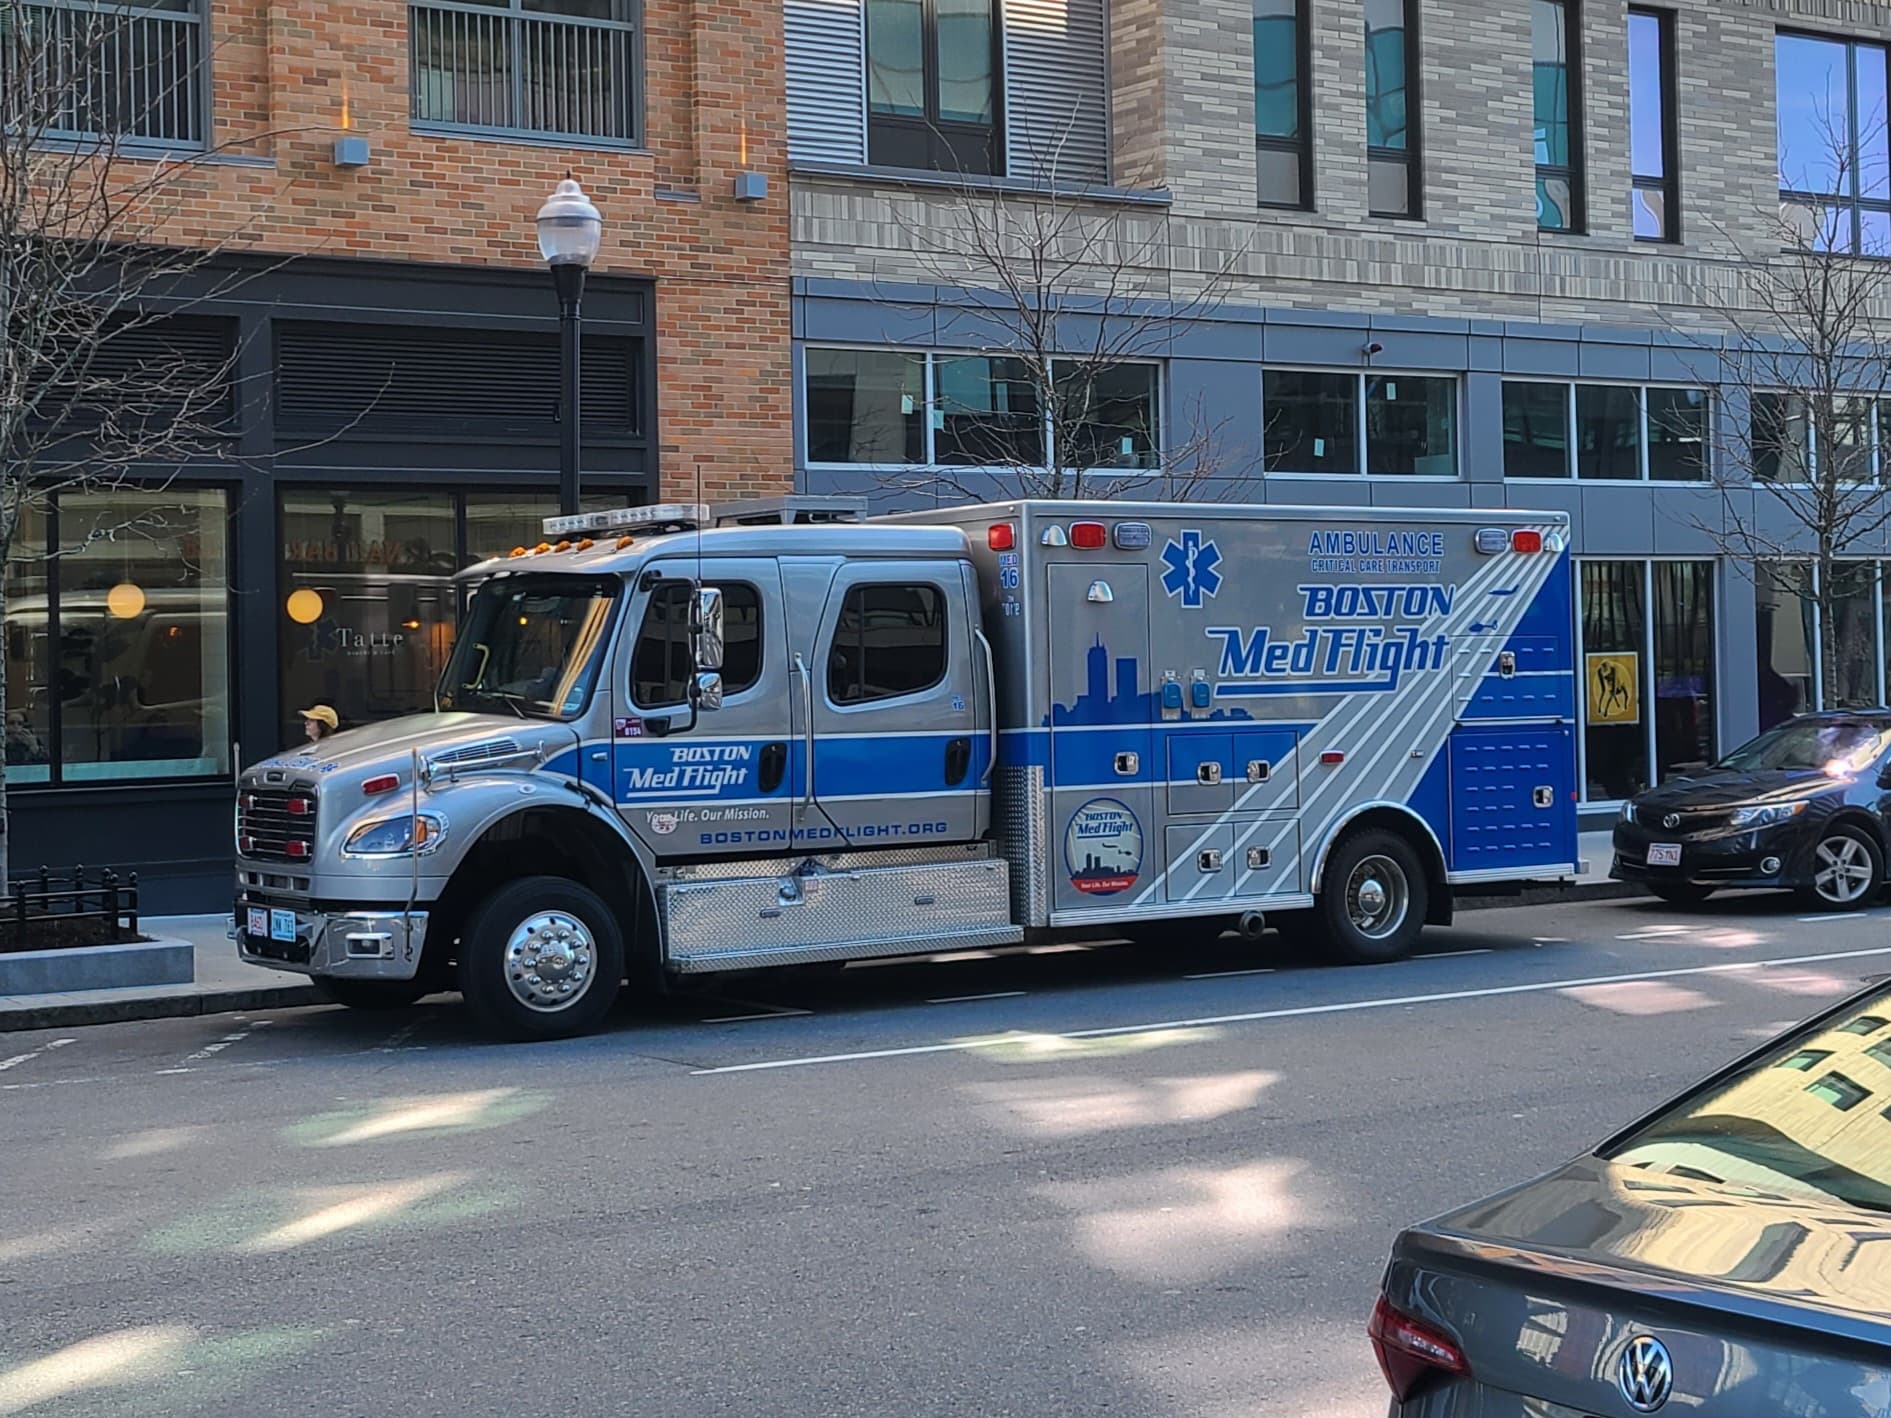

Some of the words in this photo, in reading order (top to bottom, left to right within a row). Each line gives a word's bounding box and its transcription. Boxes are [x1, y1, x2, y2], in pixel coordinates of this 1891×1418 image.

[1308, 531, 1444, 556] AMBULANCE
[1312, 559, 1356, 572] CRITICAL
[1359, 559, 1384, 572] CARE
[1387, 560, 1441, 573] TRANSPORT
[1001, 568, 1019, 588] 16
[1298, 585, 1455, 619] BOSTON
[336, 628, 403, 647] Tatte
[670, 745, 752, 762] BOSTON
[674, 809, 698, 822] Life.
[701, 810, 723, 821] Our
[724, 807, 770, 820] Mission.
[1085, 811, 1123, 821] BOSTON
[700, 822, 948, 844] BOSTONMEDFLIGHT.ORG
